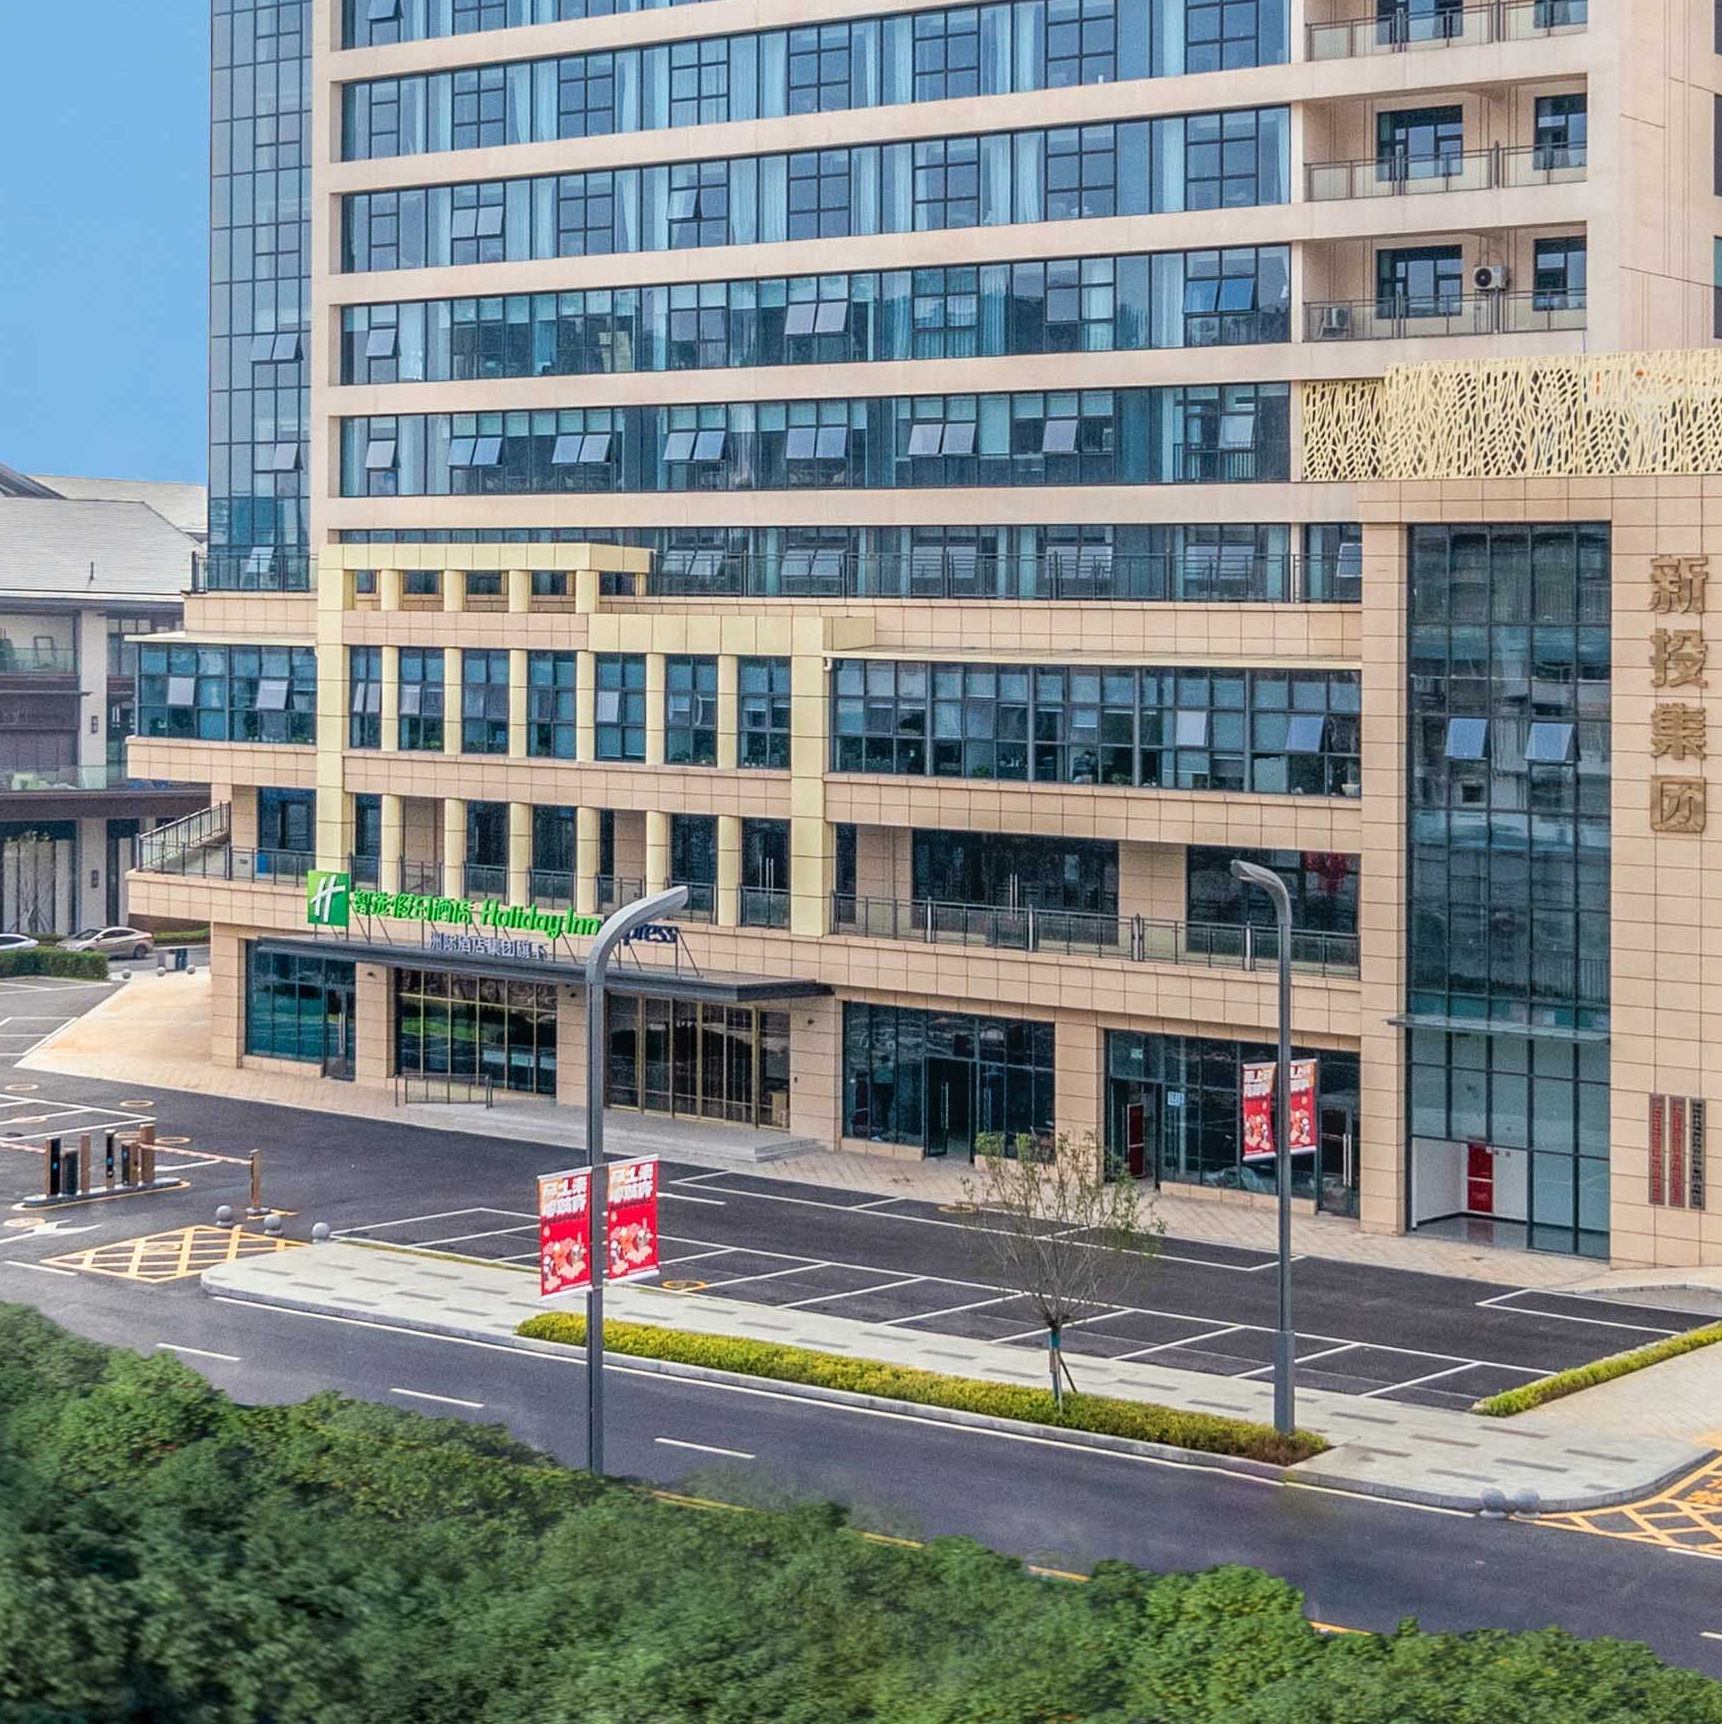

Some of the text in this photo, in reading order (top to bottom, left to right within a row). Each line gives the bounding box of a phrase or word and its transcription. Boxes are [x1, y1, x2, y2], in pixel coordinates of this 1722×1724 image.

[1649, 554, 1709, 833] 新投集团
[354, 889, 677, 945] 智选假日酒店 Holiday Inn press
[429, 931, 548, 961] 洲际酒店集团旗下
